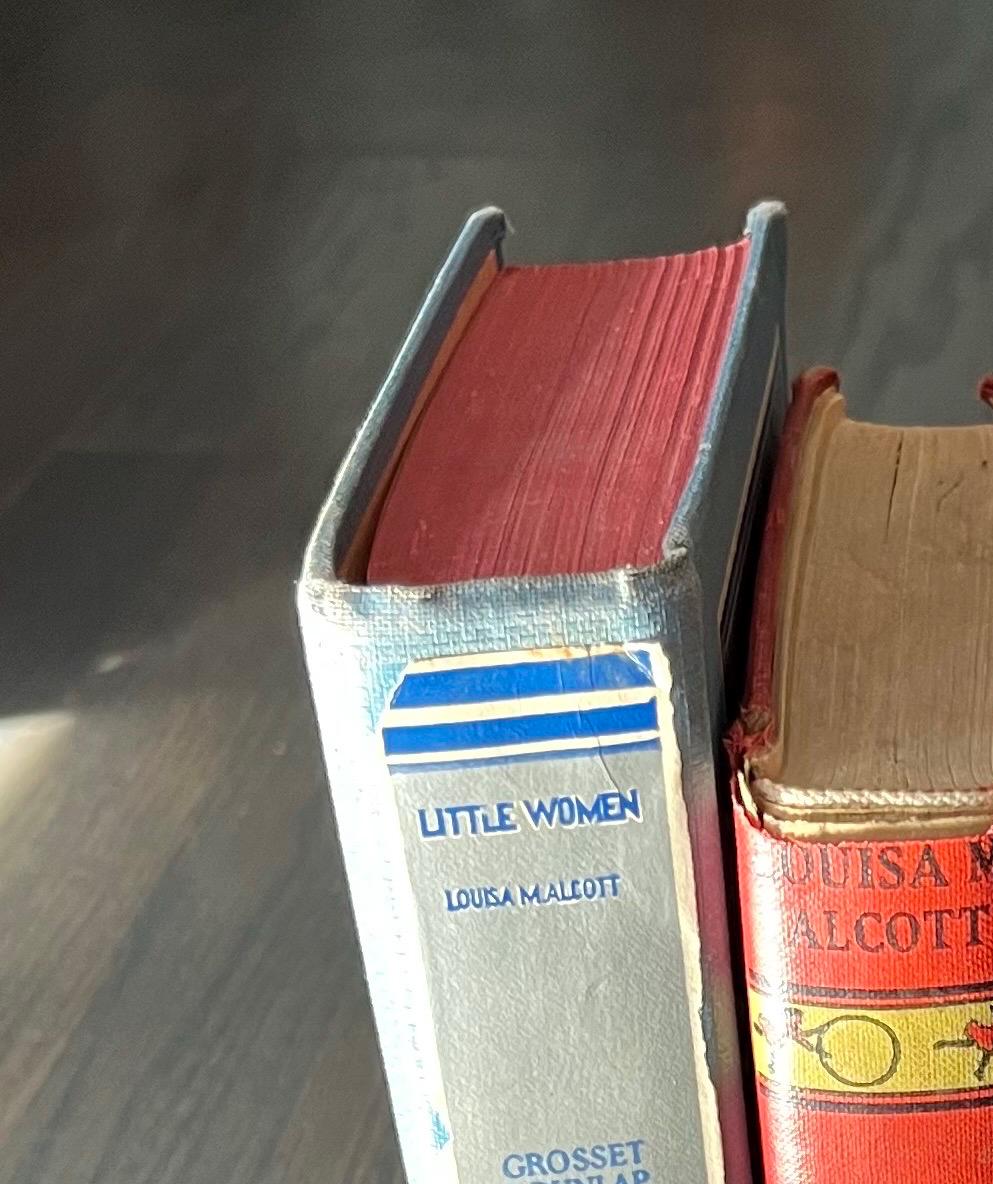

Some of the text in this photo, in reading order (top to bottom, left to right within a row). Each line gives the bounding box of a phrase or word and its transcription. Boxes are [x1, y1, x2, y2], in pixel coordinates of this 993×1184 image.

[418, 788, 641, 838] LITTLE WOMEN
[757, 842, 949, 888] OUISA
[444, 886, 515, 912] LOUISA
[791, 903, 990, 952] ALCOTT
[502, 1139, 645, 1178] GROSSET
